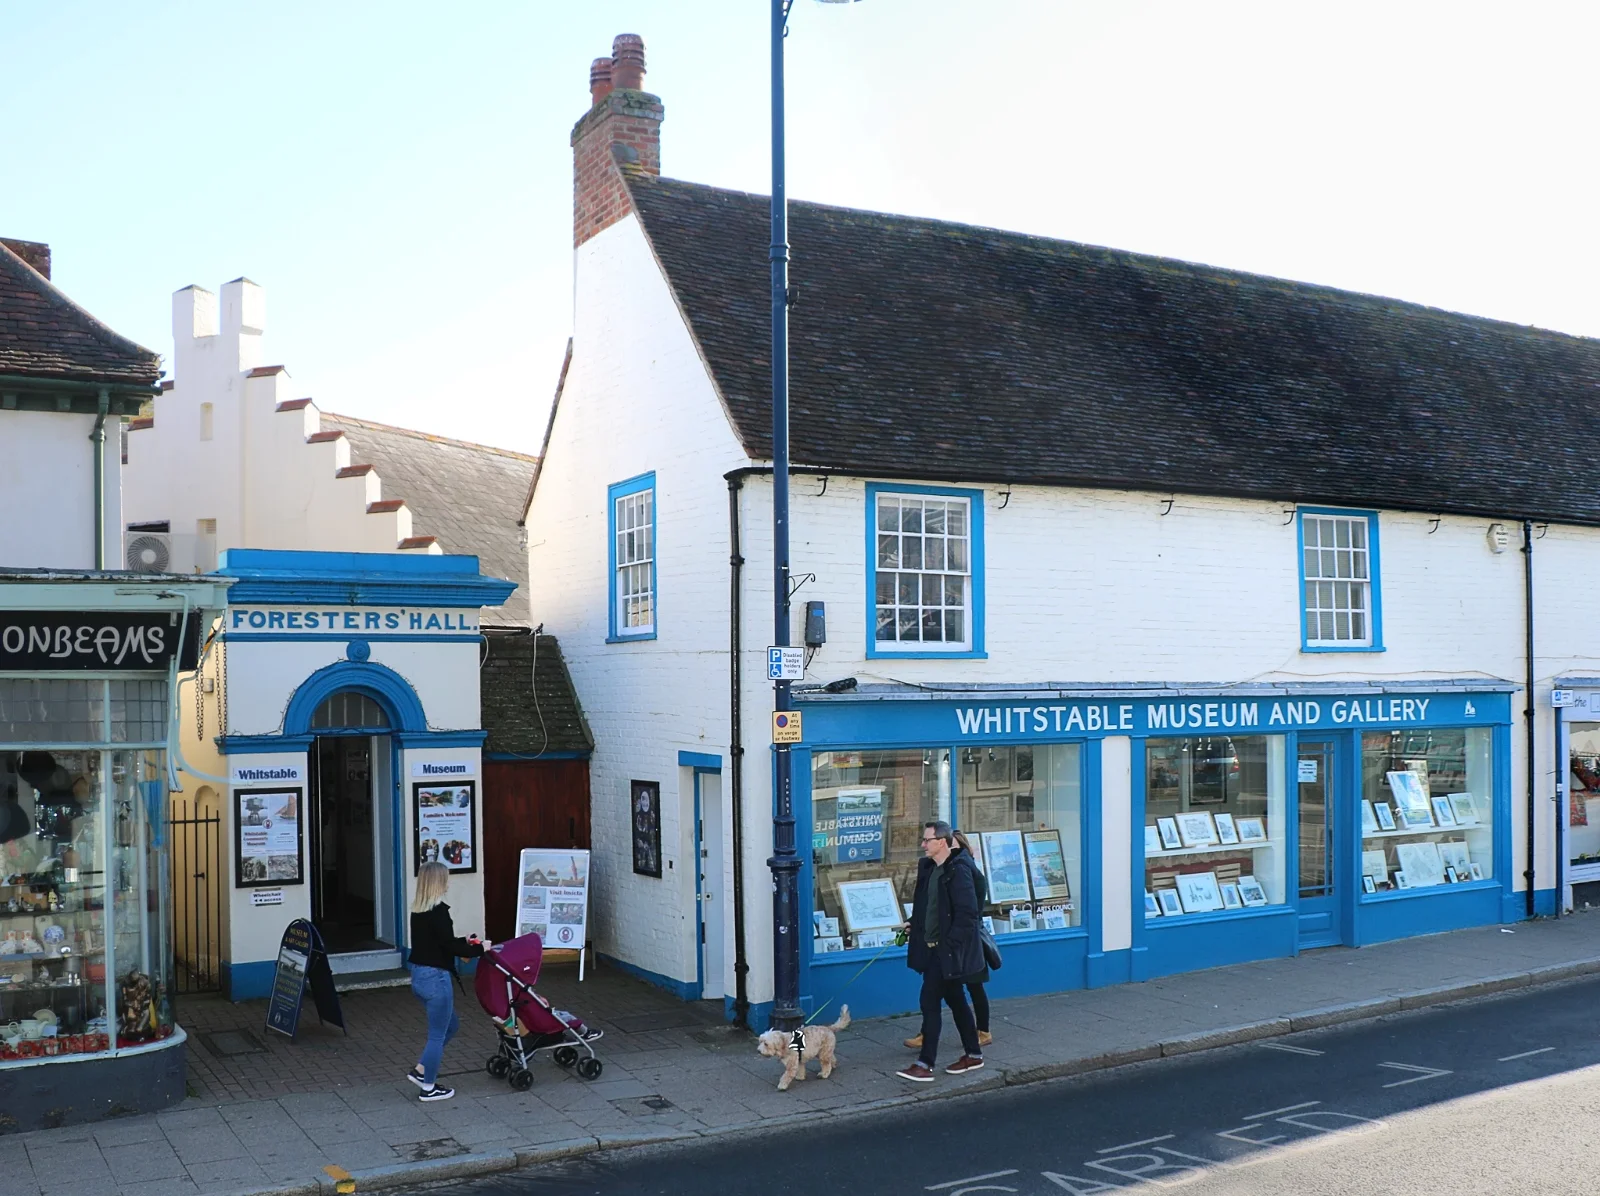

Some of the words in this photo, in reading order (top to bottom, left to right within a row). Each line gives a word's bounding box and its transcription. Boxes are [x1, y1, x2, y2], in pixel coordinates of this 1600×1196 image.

[2, 625, 165, 665] ONBEAMS
[772, 650, 780, 661] P
[955, 704, 1134, 734] WHITSTABLE
[1147, 701, 1259, 729] MUSEUM
[1268, 700, 1321, 725] AND
[1331, 698, 1430, 723] GALLERY
[238, 768, 298, 780] Whitstable
[422, 764, 466, 774] Museum
[1052, 903, 1076, 912] COUNCIL
